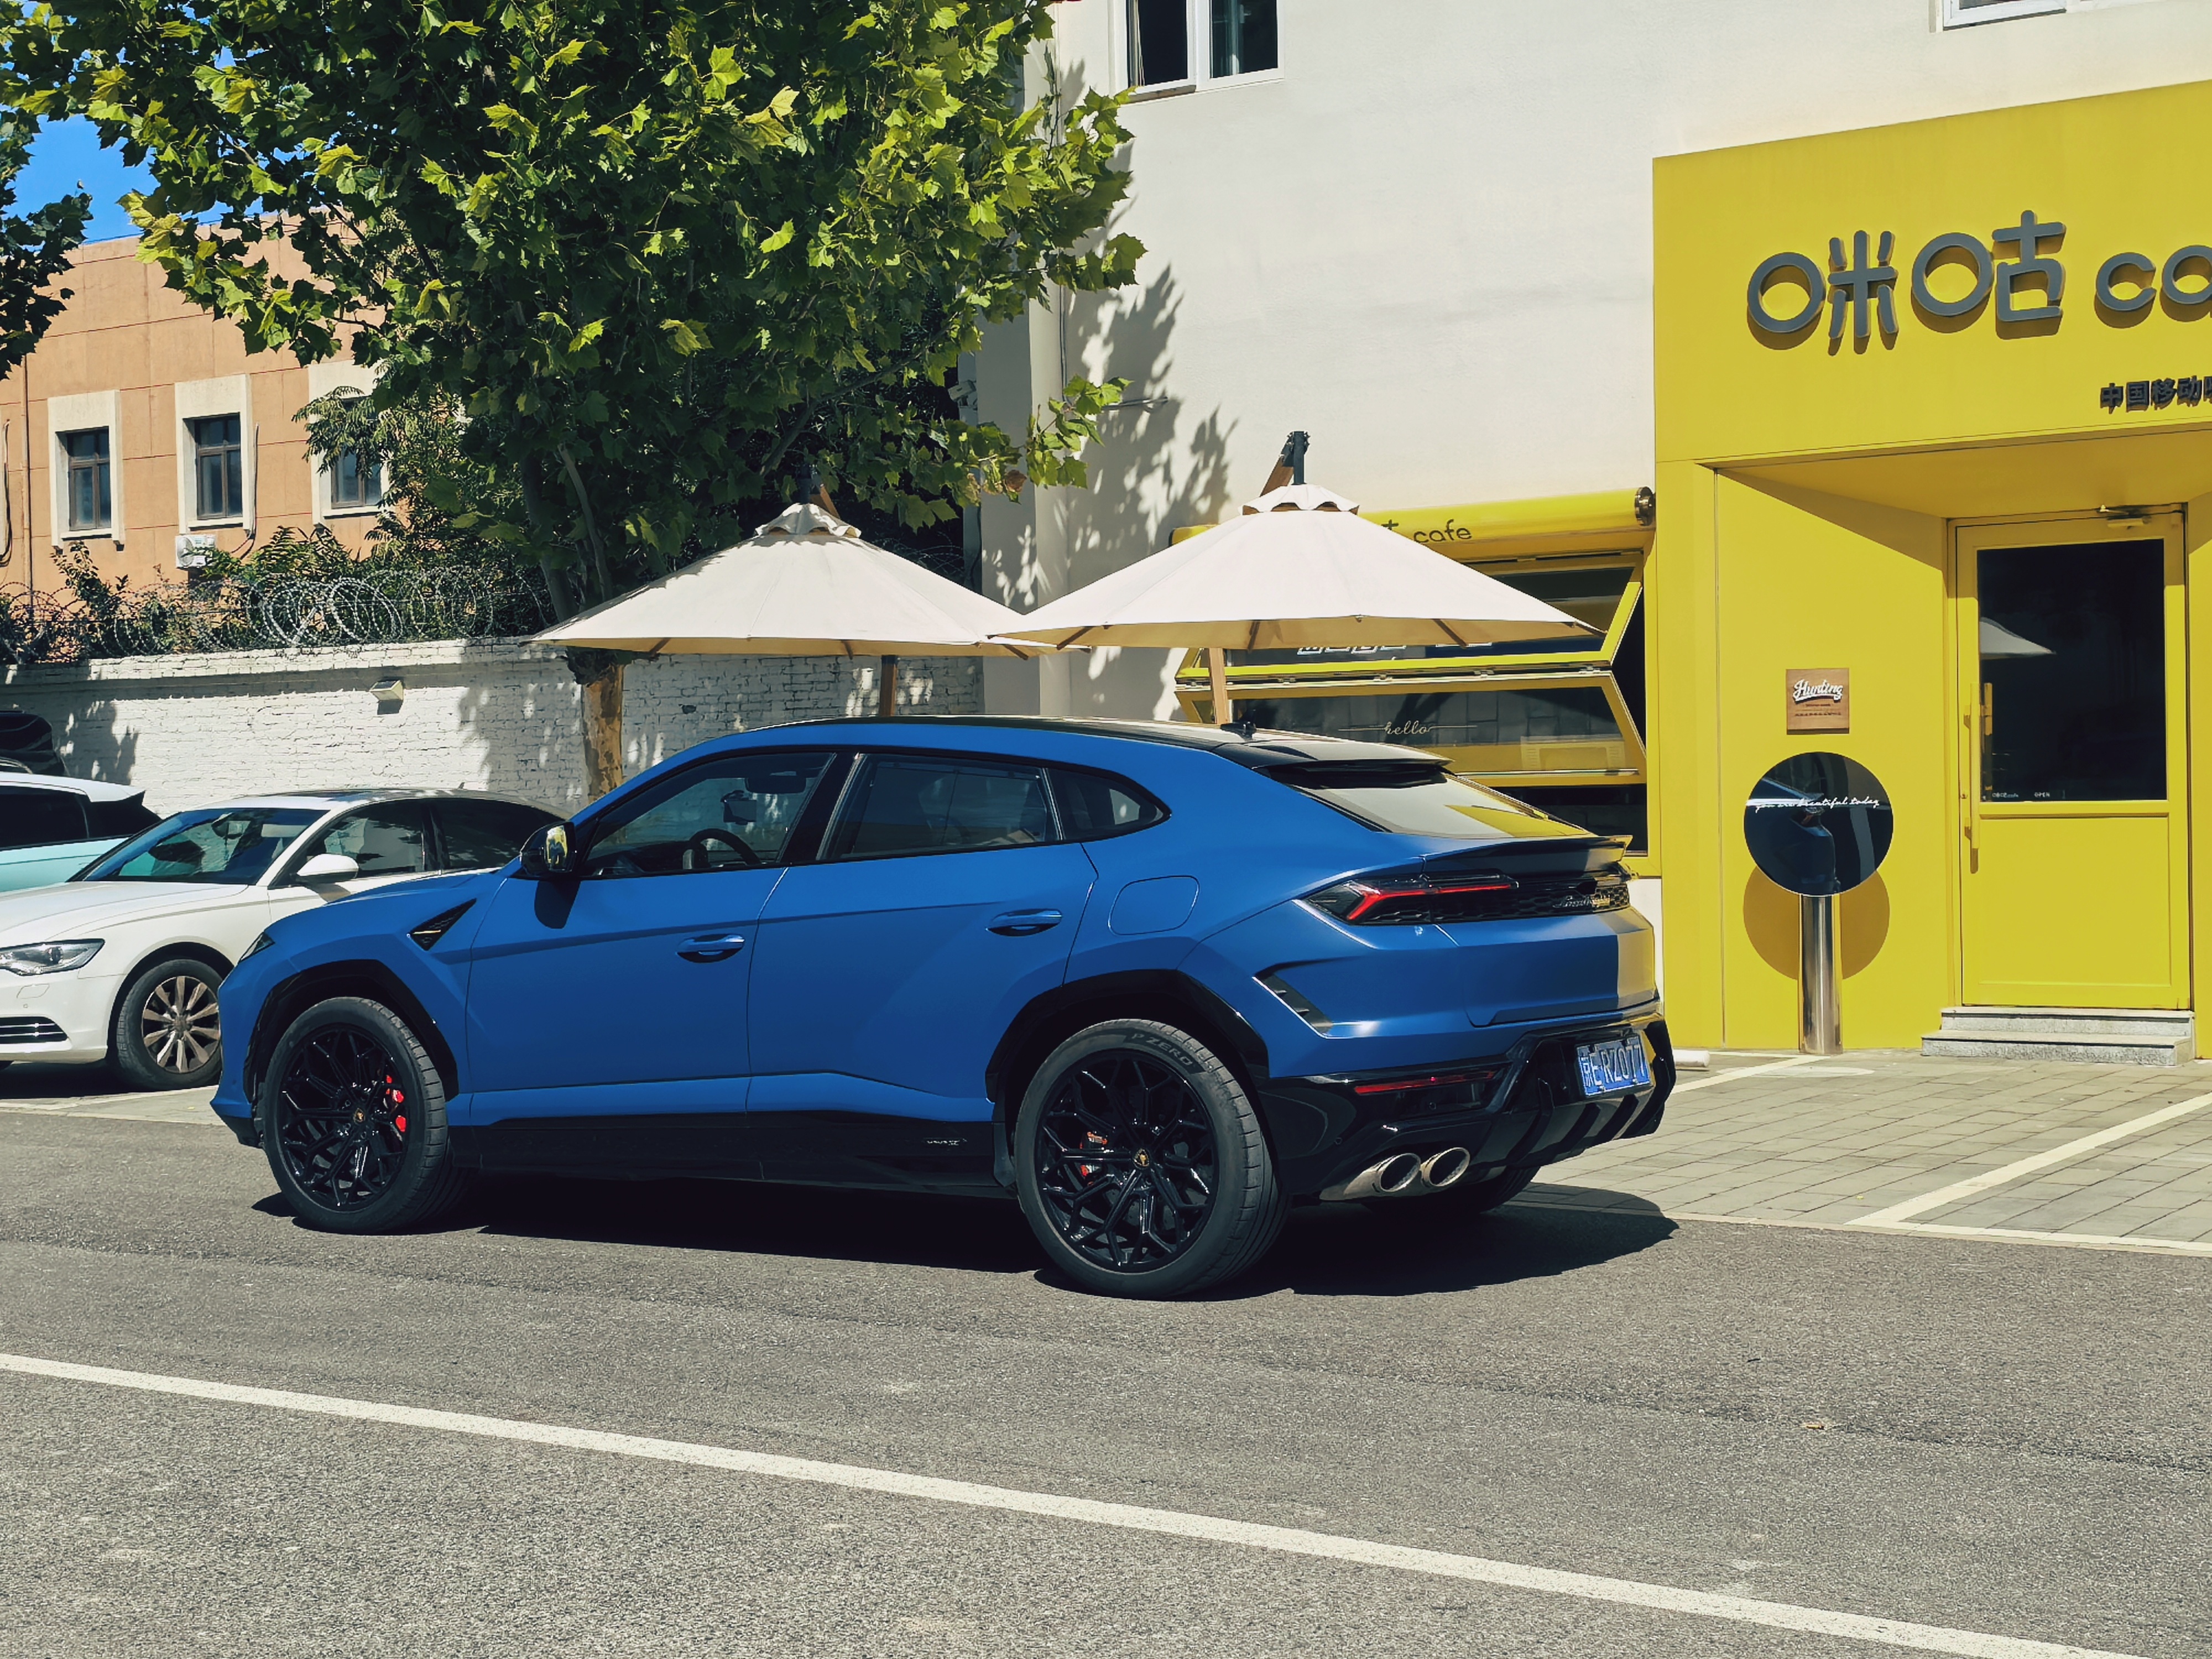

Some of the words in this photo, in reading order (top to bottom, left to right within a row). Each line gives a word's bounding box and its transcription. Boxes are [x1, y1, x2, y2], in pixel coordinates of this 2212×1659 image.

[1747, 210, 2065, 339] 咪咕
[1413, 519, 1472, 544] cafe
[1384, 720, 1430, 735] hello
[1146, 1037, 1193, 1066] ZERO
